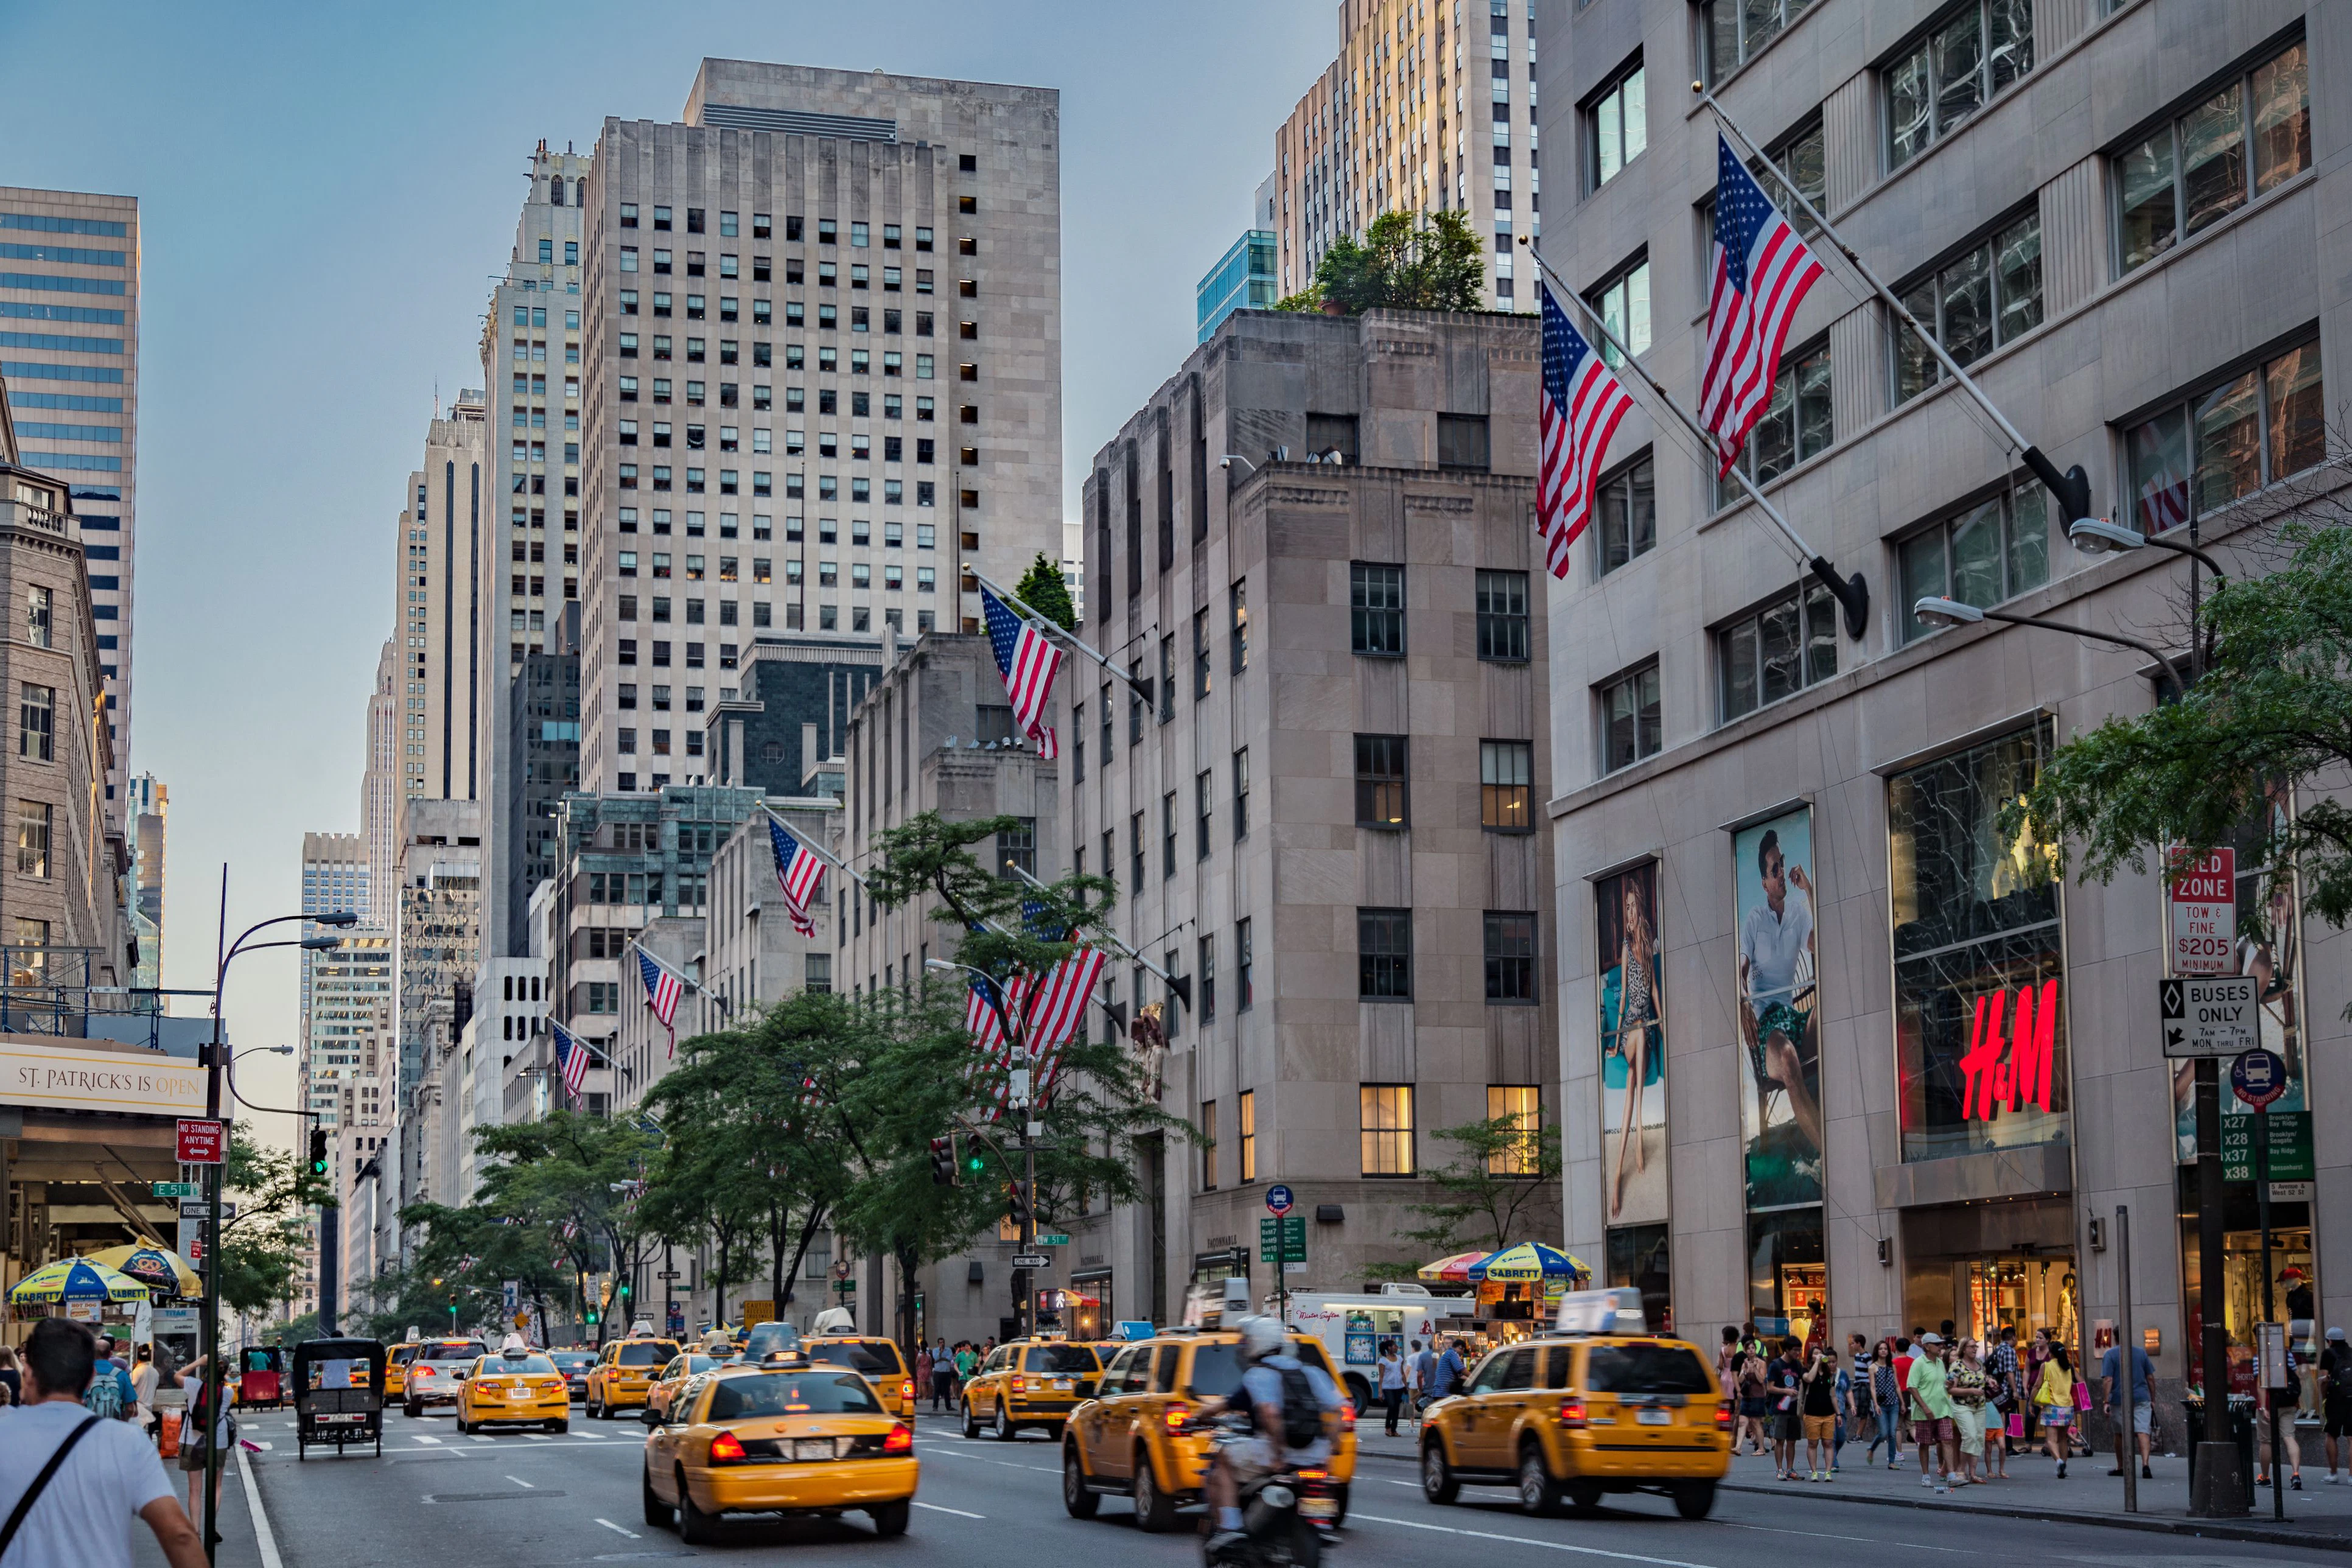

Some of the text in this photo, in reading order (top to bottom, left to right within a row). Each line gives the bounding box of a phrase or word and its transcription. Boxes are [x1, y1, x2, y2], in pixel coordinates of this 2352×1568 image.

[2192, 855, 2221, 873] ED
[2179, 878, 2227, 897] ZONE
[2186, 906, 2221, 920] TOW &
[2189, 922, 2215, 934] FINE
[2179, 938, 2228, 956] $205
[2182, 959, 2224, 970] MINIMUM
[2191, 985, 2249, 1003] BUSES
[2199, 1006, 2243, 1023] ONLY
[2199, 1027, 2215, 1037] 7AM
[2229, 1026, 2246, 1035] 7PM
[2192, 1039, 2211, 1048] MON
[2239, 1037, 2254, 1046] FRI
[1959, 979, 2057, 1121] H&M
[19, 1066, 199, 1097] ST. PATRICK'S IS OPEN
[2236, 1086, 2281, 1103] NO STANDING
[180, 1123, 220, 1134] NO STANDING
[2224, 1116, 2247, 1129] x27
[184, 1136, 214, 1146] ANYTIME
[2225, 1133, 2248, 1145] x28
[2225, 1149, 2247, 1162] x37
[2225, 1166, 2249, 1179] x38
[158, 1185, 166, 1195] E
[170, 1185, 182, 1195] 51
[1274, 1204, 1291, 1213] STANDING
[1207, 1234, 1237, 1251] FAÇONNABLE
[1489, 1269, 1540, 1278] SABRETT
[1791, 1276, 1814, 1285] SAE
[16, 1292, 61, 1301] SABRETT
[111, 1289, 147, 1298] SABRETT
[1296, 1310, 1318, 1320] Mister
[1320, 1311, 1340, 1322] Softee
[2235, 1373, 2254, 1381] SHORTS
